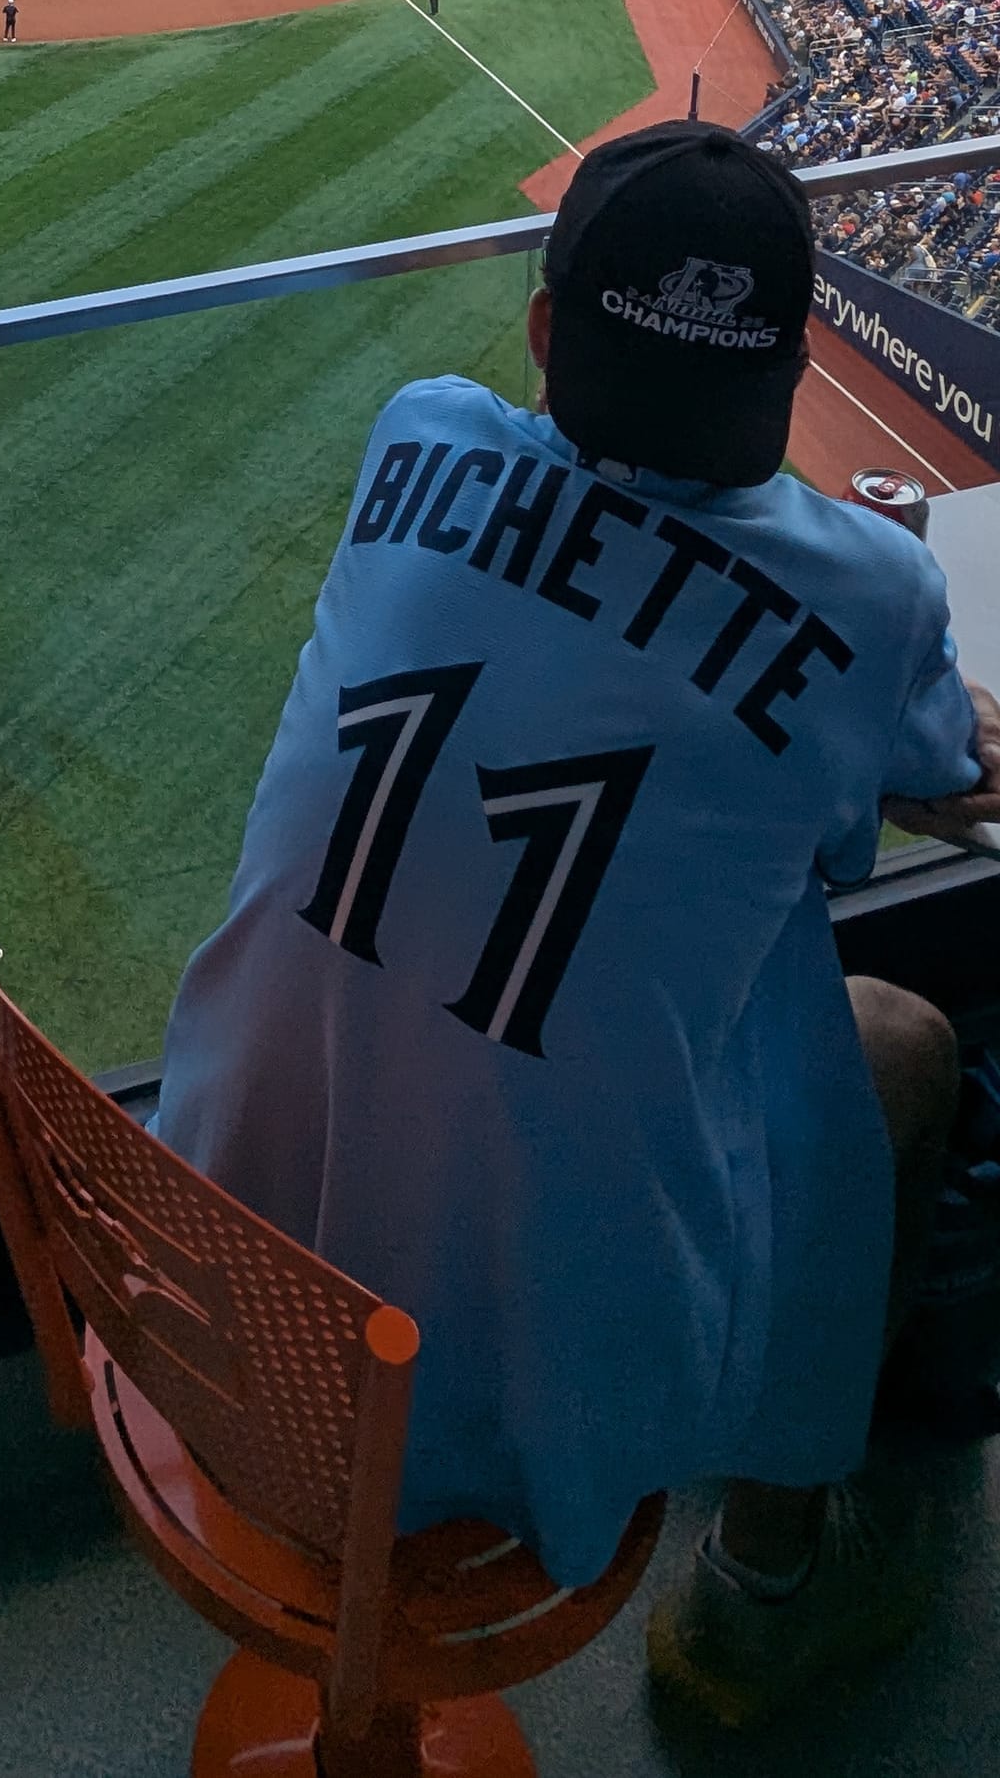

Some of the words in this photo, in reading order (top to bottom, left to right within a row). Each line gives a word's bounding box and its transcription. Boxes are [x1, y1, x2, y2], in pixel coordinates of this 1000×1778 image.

[602, 290, 780, 349] CHAMPIONS
[813, 273, 933, 392] erywhere
[935, 372, 993, 443] you
[350, 441, 856, 757] BICHETTE
